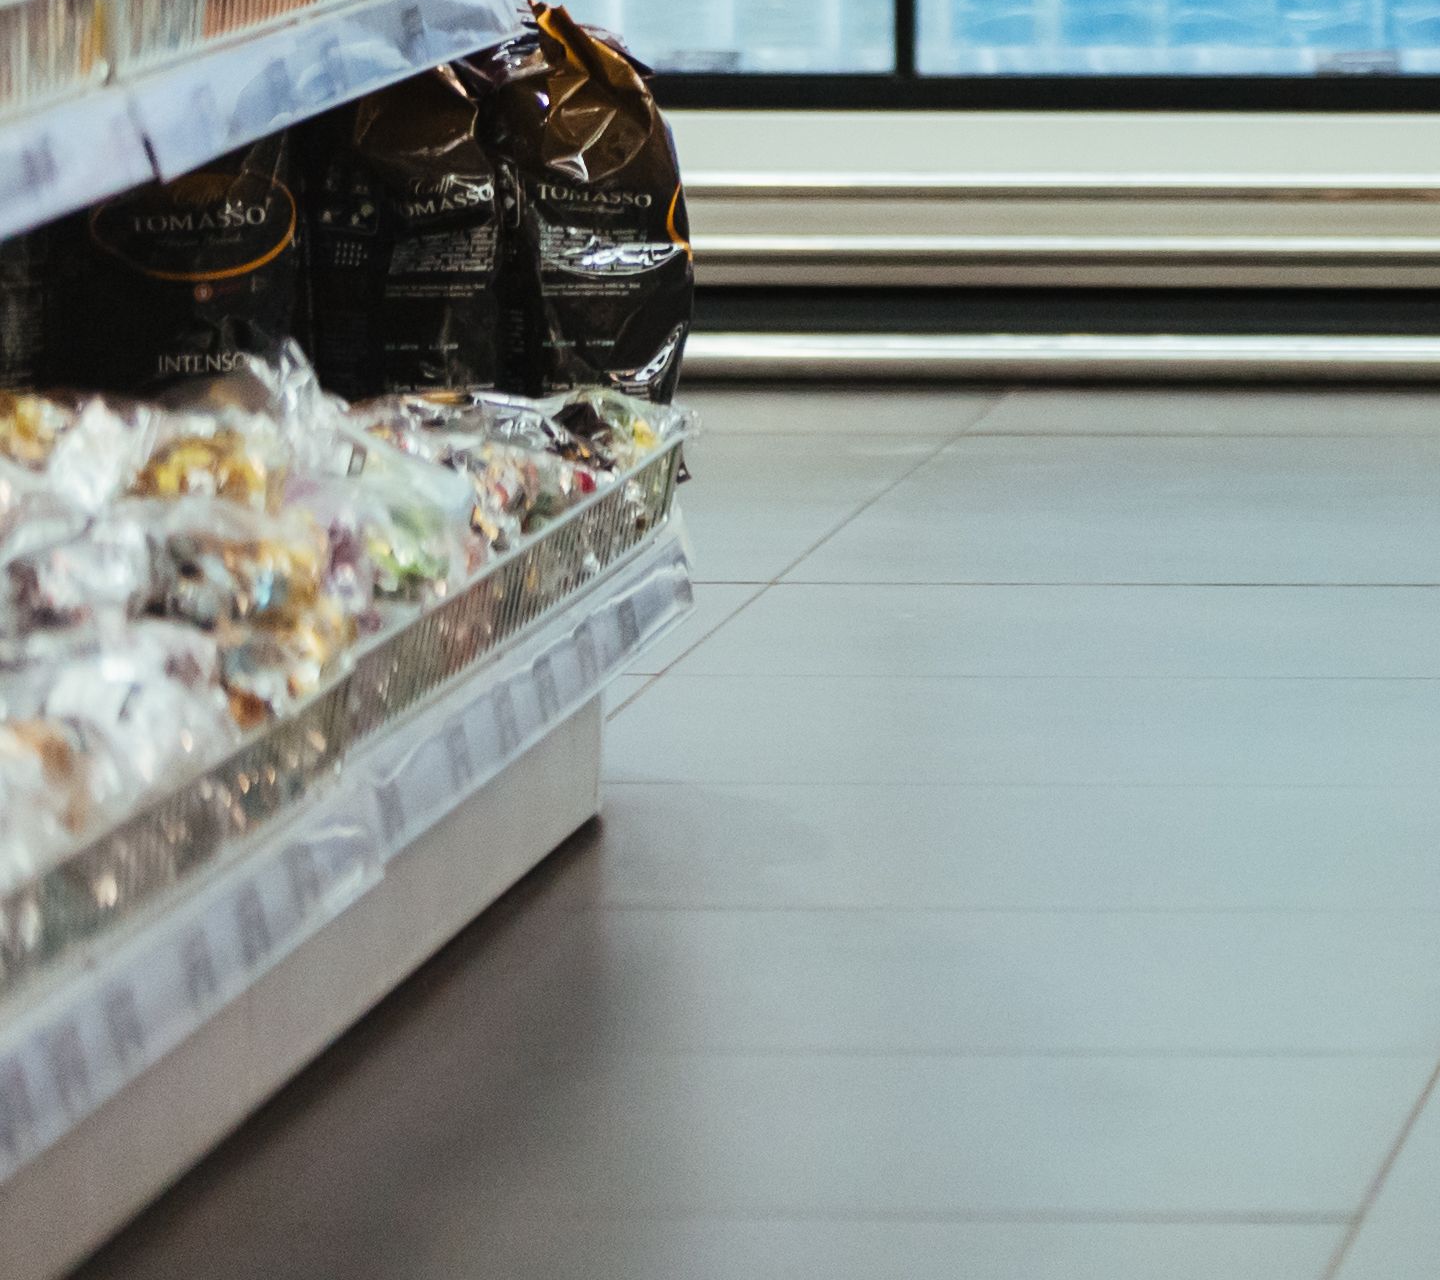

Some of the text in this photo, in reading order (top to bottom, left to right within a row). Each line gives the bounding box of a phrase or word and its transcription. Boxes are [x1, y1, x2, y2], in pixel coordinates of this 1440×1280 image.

[402, 188, 494, 218] OMASSO
[538, 182, 652, 208] TOMASSO
[132, 206, 267, 234] TOMASSO
[157, 351, 248, 374] INTENSO
